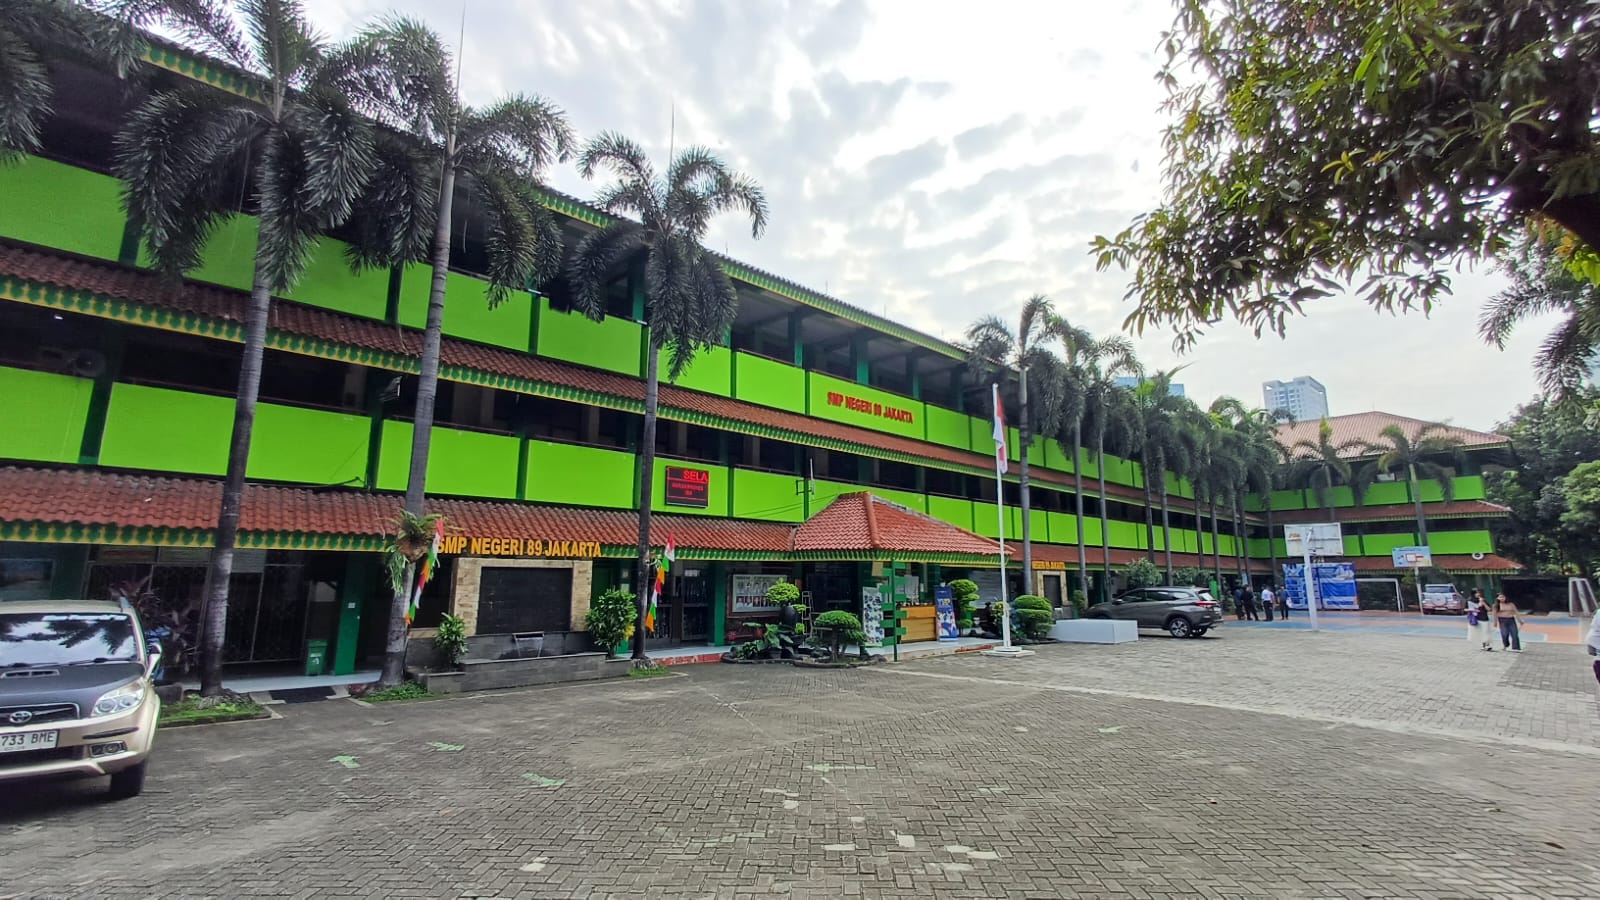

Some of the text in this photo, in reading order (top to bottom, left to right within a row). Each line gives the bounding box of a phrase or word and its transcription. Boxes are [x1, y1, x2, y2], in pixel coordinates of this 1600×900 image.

[884, 406, 914, 424] JAKARTA
[683, 470, 708, 481] SELA
[437, 535, 601, 558] SMP NEGERI 89 JAKARTA
[1, 731, 55, 746] 733 BME
